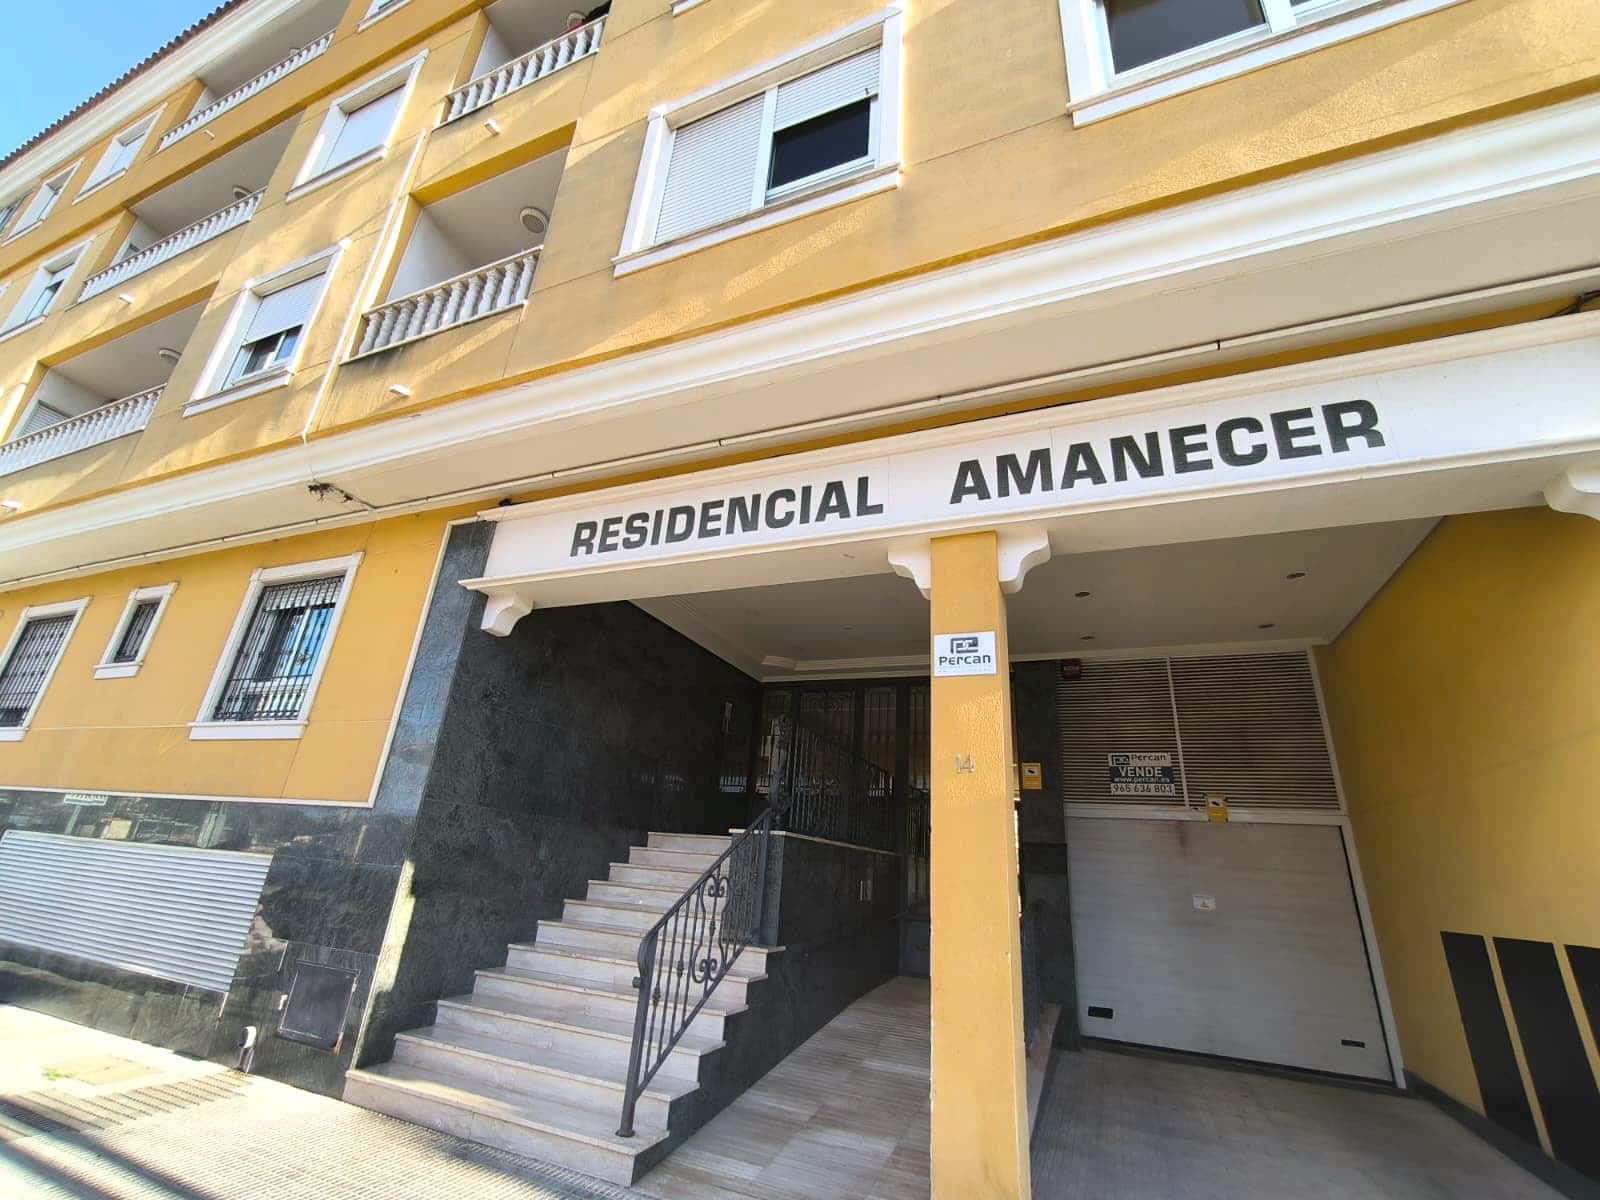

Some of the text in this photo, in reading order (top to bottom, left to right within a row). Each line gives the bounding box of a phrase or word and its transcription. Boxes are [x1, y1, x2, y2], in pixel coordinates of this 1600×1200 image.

[571, 399, 1385, 556] RESIDENCIAL AMANECER
[938, 654, 992, 666] Percan
[955, 753, 974, 774] 14
[1118, 767, 1162, 776] VENDE
[1113, 784, 1173, 793] 965 636 803
